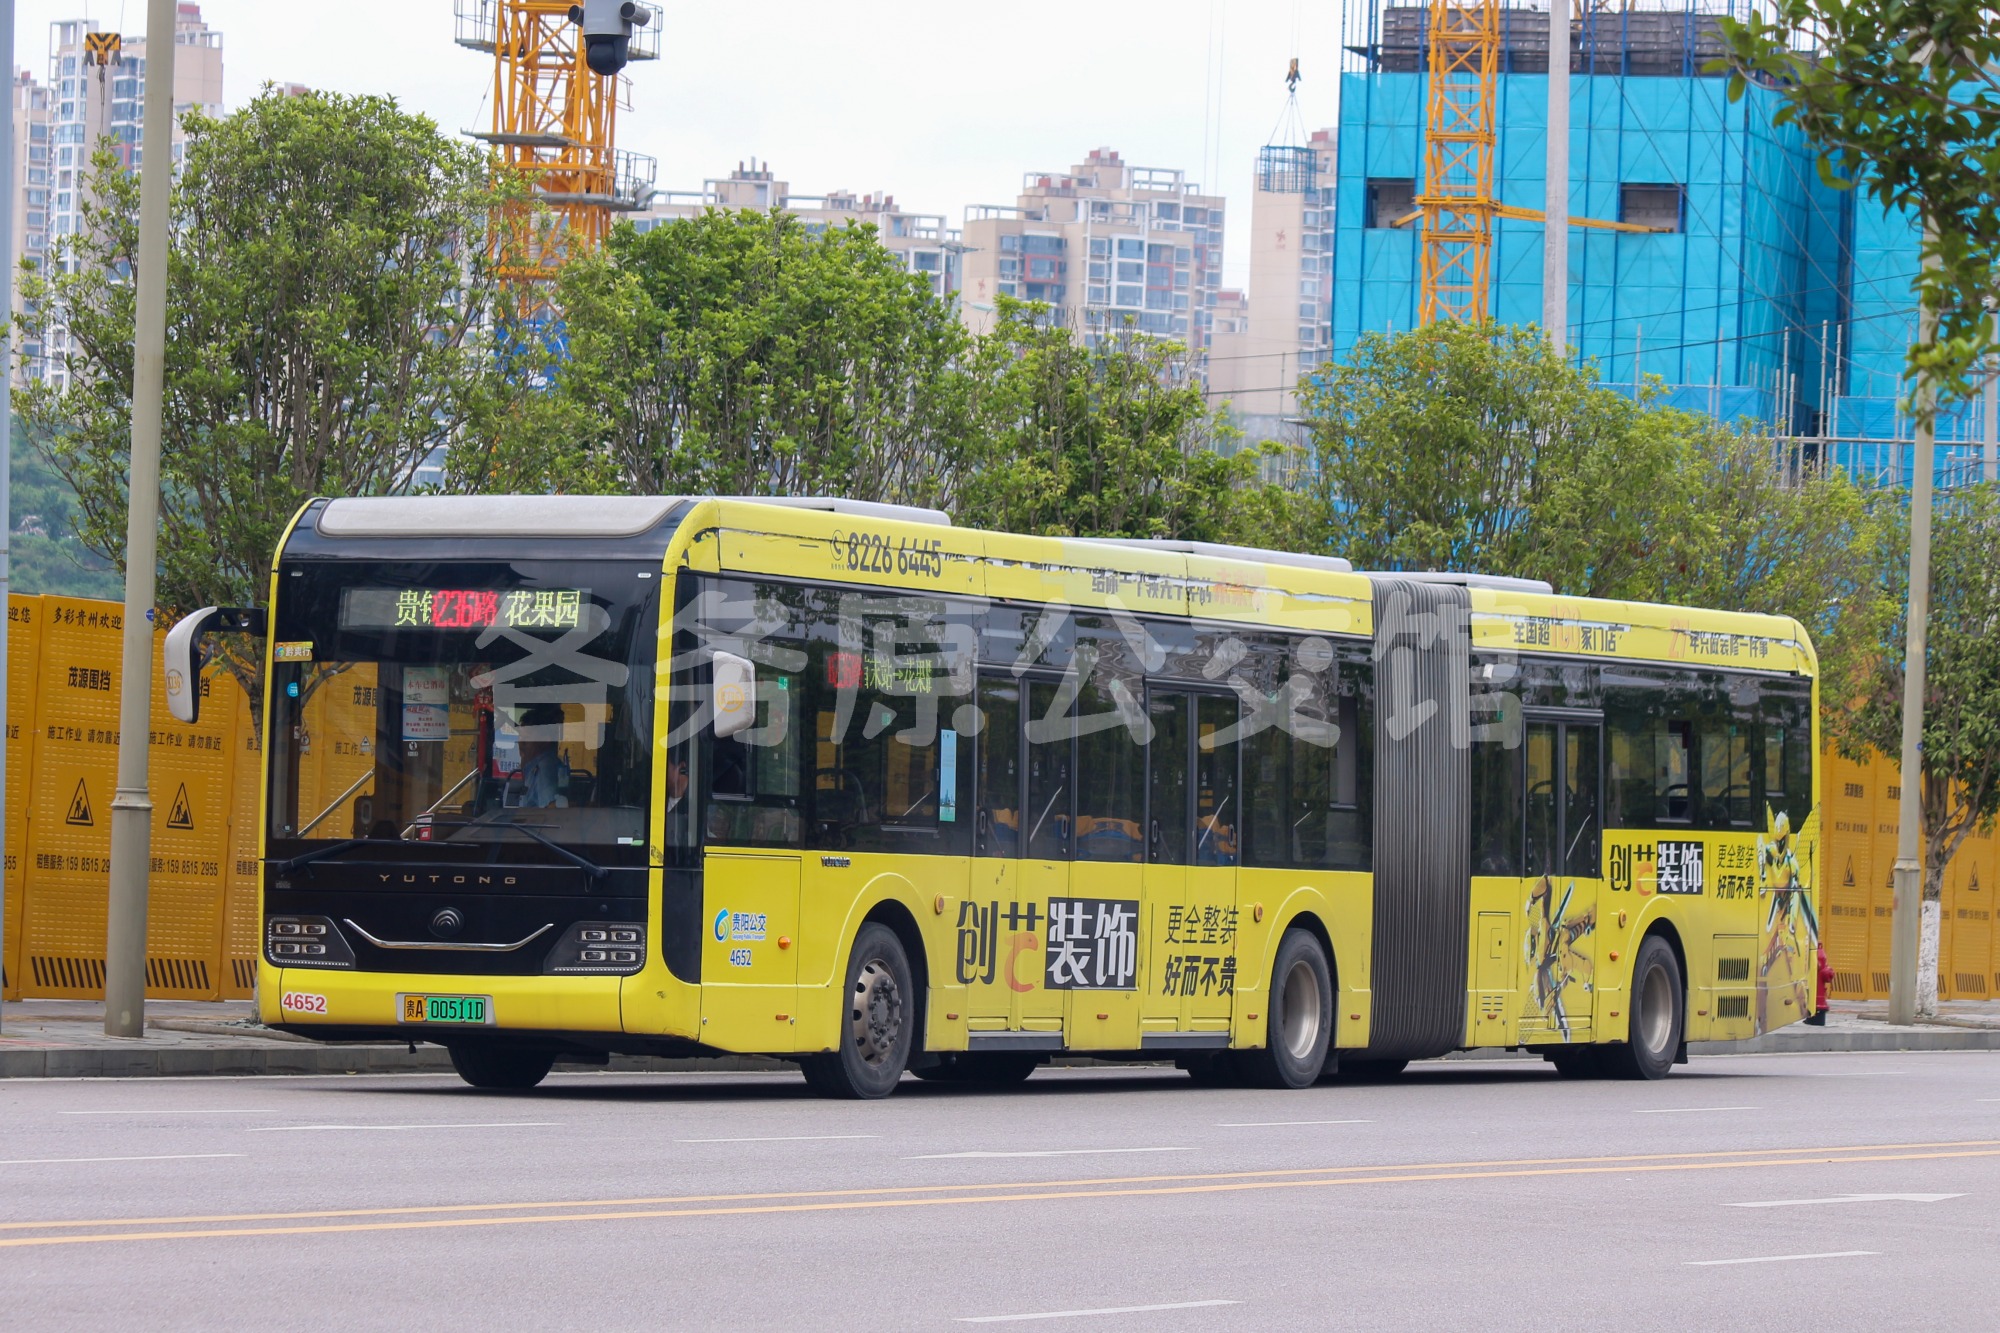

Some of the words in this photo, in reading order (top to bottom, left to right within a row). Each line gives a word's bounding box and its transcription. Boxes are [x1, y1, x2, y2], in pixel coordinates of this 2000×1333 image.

[848, 532, 892, 574] 8226
[898, 537, 941, 578] 6445
[53, 606, 122, 630] 多彩贵州欢迎
[506, 590, 580, 628] 花果园
[285, 647, 311, 657] 黔爽行
[68, 666, 111, 691] 茂源围挡
[48, 726, 81, 742] 施工作业
[88, 729, 121, 746] 请勿靠近
[188, 734, 221, 751] 请勿靠近
[81, 857, 99, 873] 8515
[181, 860, 199, 875] 8515
[201, 861, 219, 876] 2955
[1610, 841, 1704, 896] 创艺装饰
[1717, 844, 1755, 870] 更全整装
[379, 874, 516, 885] YUTONG
[1716, 873, 1754, 900] 好而不贵
[732, 914, 767, 932] 贵阳公交
[1165, 904, 1239, 944] 更全整装
[956, 898, 1138, 992] 创艺装饰
[730, 949, 752, 966] 4652
[1162, 954, 1238, 997] 好而不贵
[283, 992, 327, 1013] 4652
